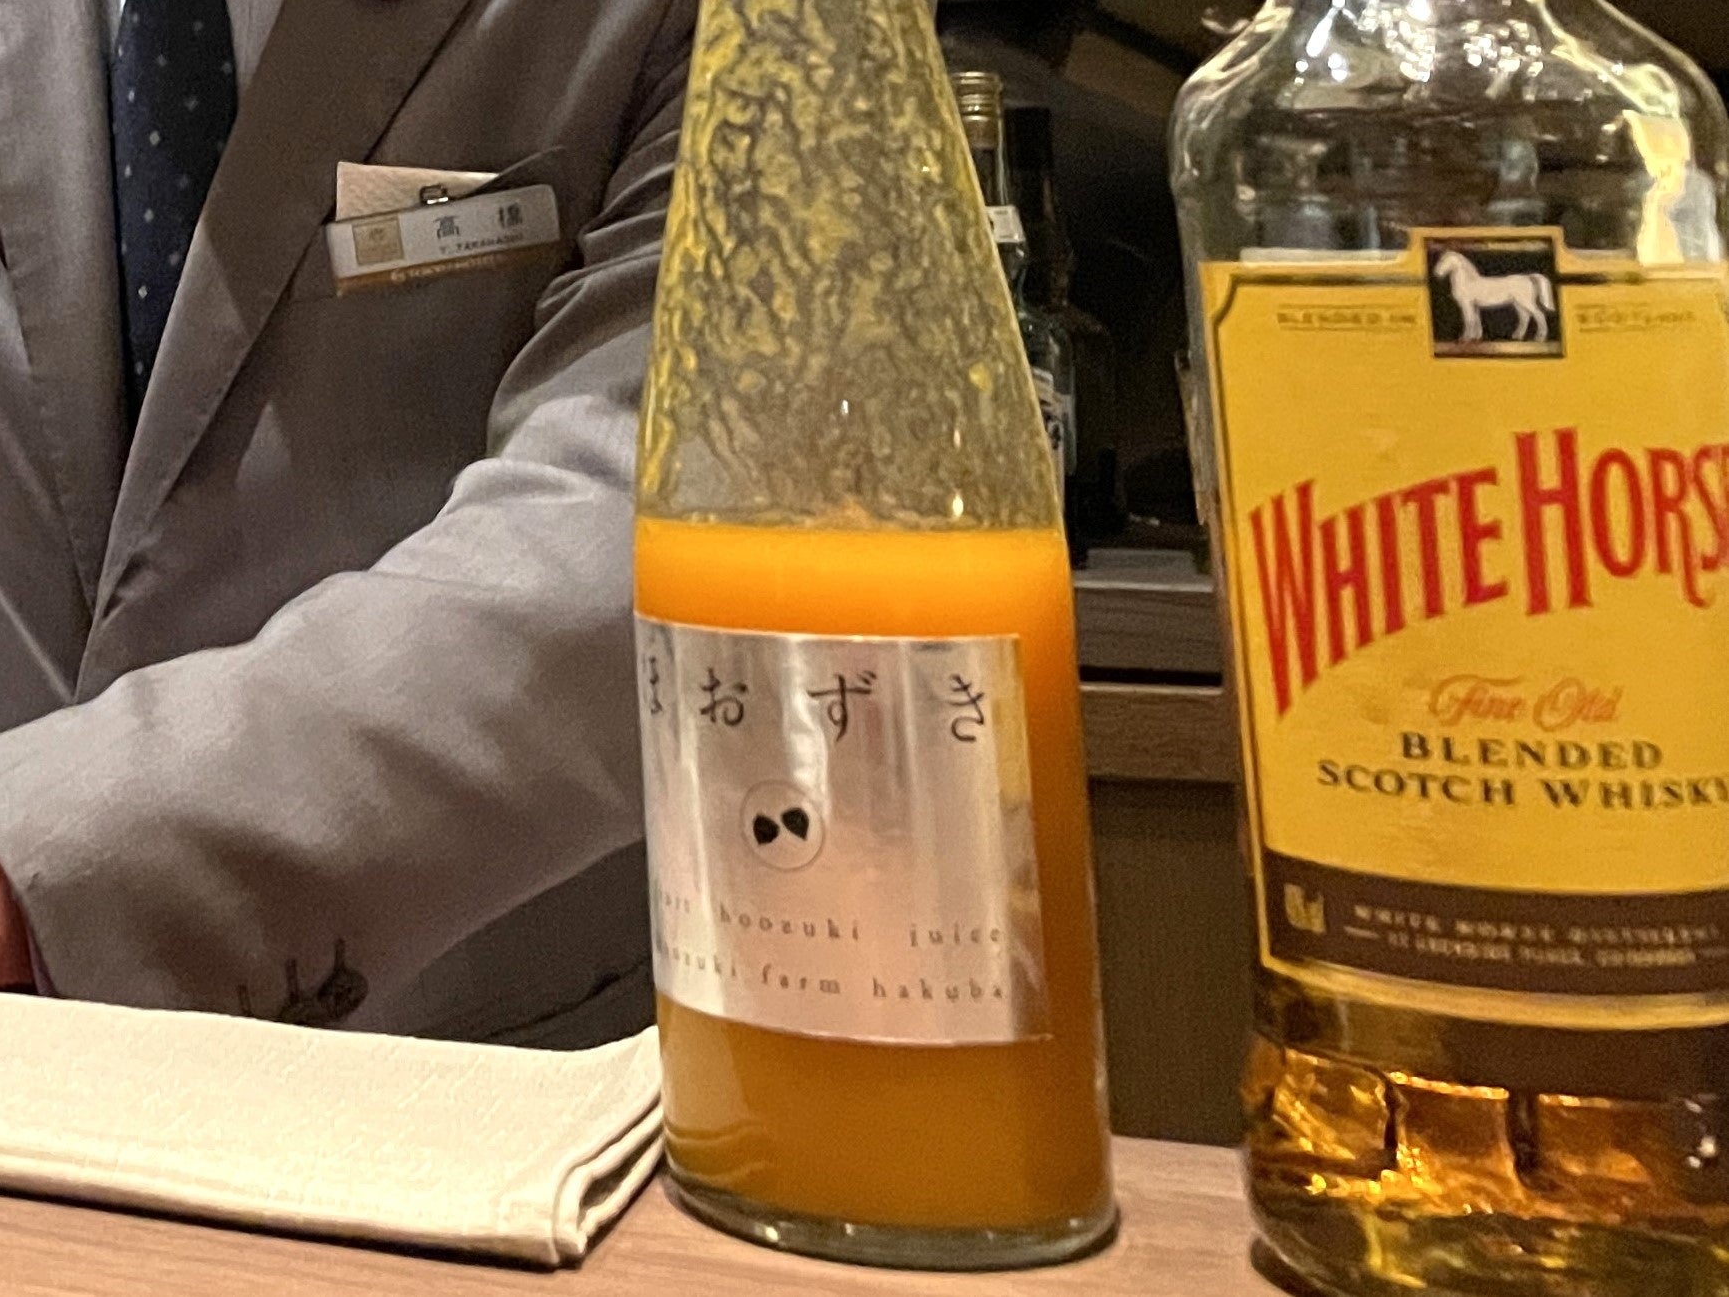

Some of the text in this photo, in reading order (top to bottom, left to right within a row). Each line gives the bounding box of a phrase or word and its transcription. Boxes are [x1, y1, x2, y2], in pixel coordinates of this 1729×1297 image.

[1250, 465, 1509, 723] WHITE
[1401, 731, 1663, 771] BLENDED
[1317, 759, 1515, 806] SCOTCH
